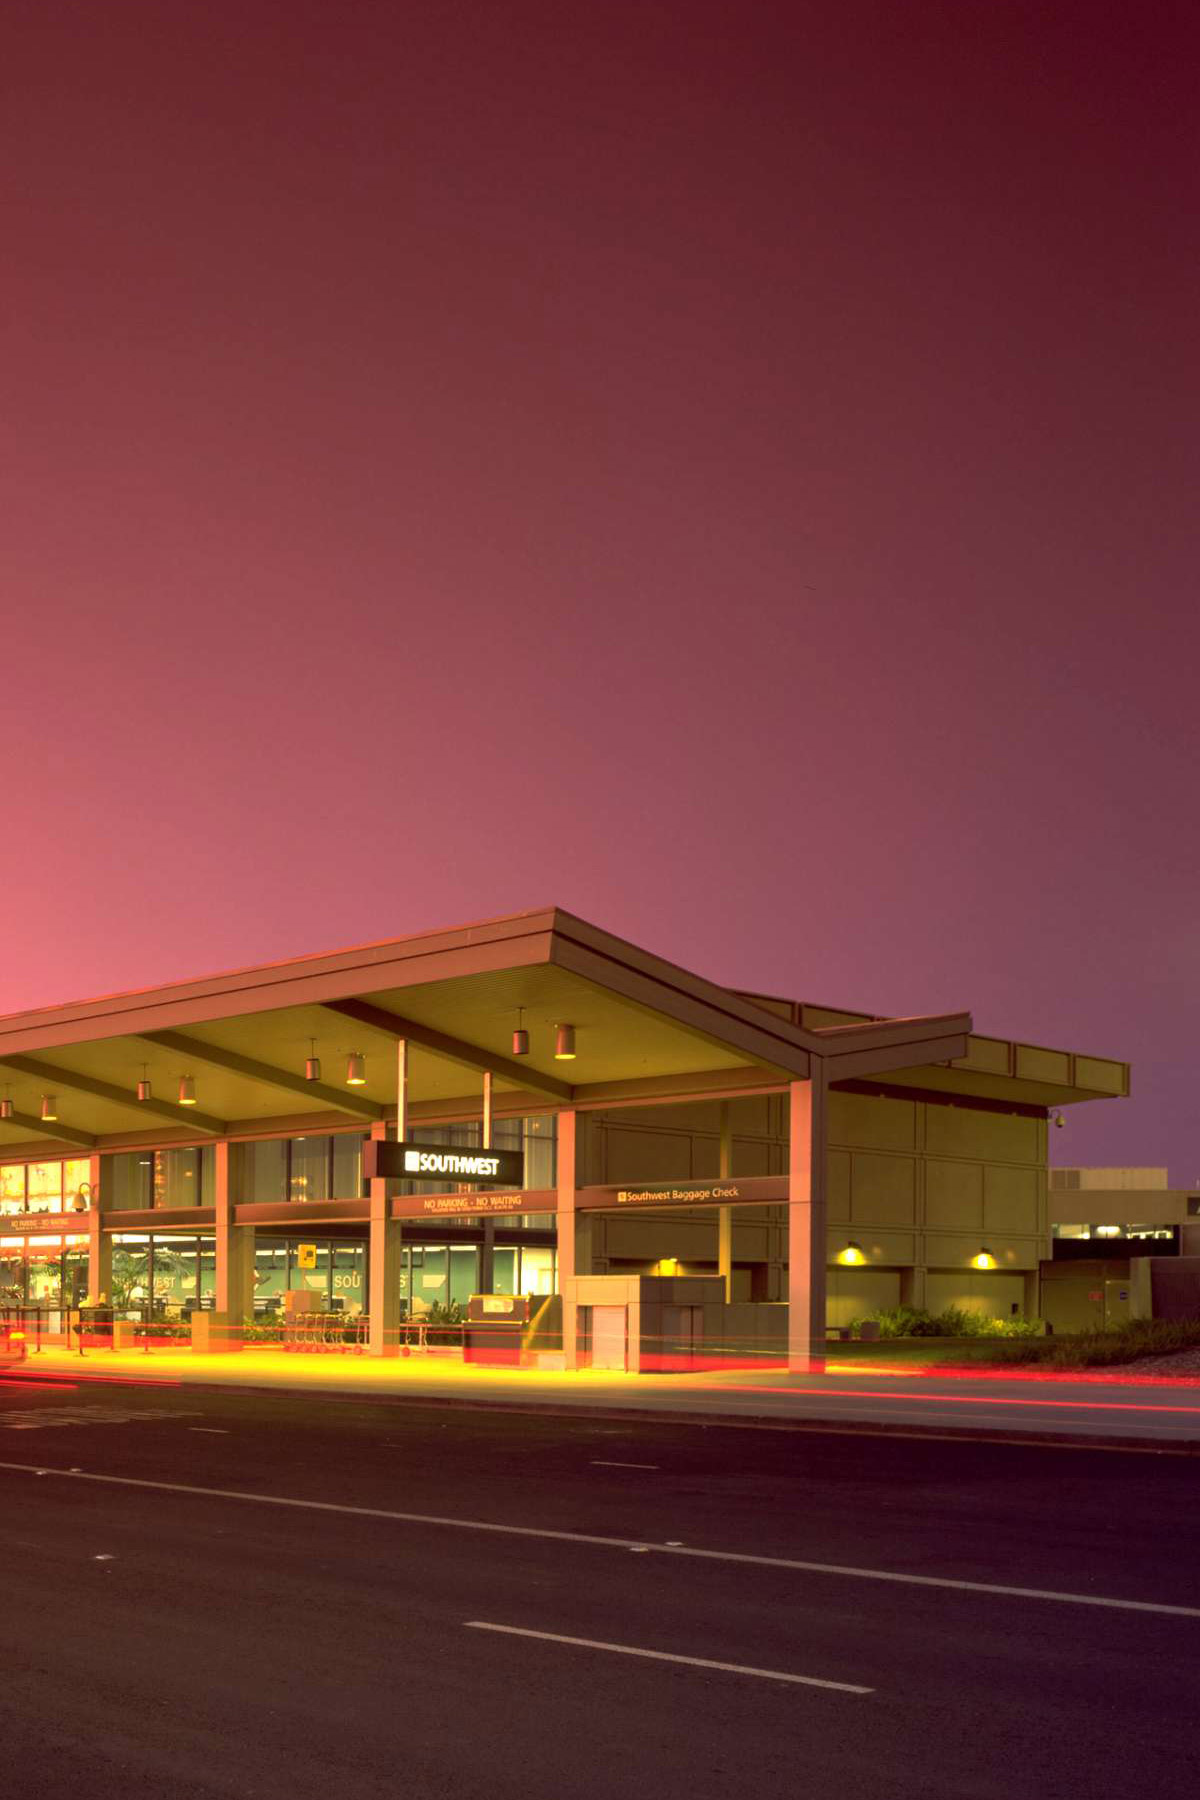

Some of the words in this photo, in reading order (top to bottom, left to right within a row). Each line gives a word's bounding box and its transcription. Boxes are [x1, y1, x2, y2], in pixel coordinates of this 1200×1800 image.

[420, 1153, 500, 1176] SOUTHWEST
[424, 1199, 436, 1209] NO
[437, 1198, 468, 1208] PARKING
[476, 1197, 488, 1207] NO
[490, 1195, 522, 1206] WAITING
[627, 1191, 671, 1202] Southwest
[672, 1189, 711, 1201] Baggage
[712, 1187, 739, 1198] Check
